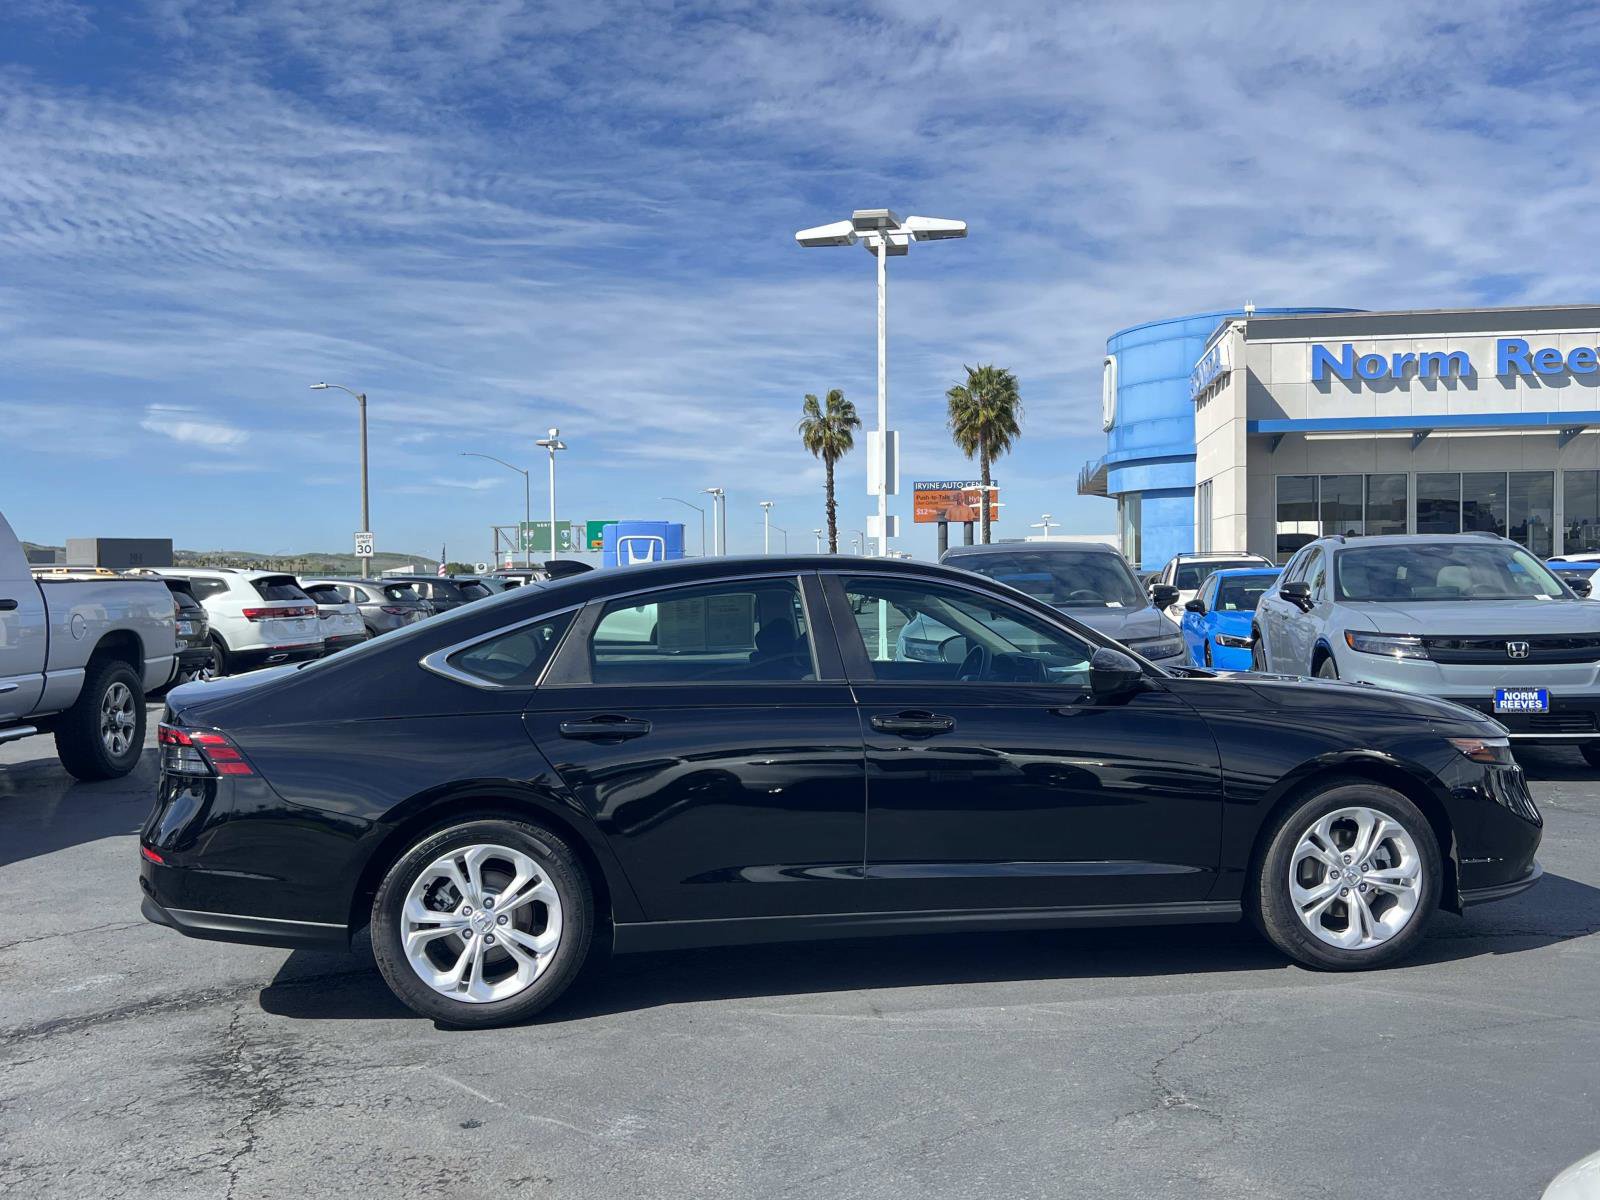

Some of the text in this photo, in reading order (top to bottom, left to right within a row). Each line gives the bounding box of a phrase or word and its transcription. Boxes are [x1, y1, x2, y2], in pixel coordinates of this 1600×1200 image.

[1311, 338, 1600, 381] Norm Ree
[915, 481, 996, 490] IRVINE AUTO CENR
[357, 544, 372, 554] 30
[1503, 692, 1539, 701] NORM
[1500, 700, 1543, 709] REEVES
